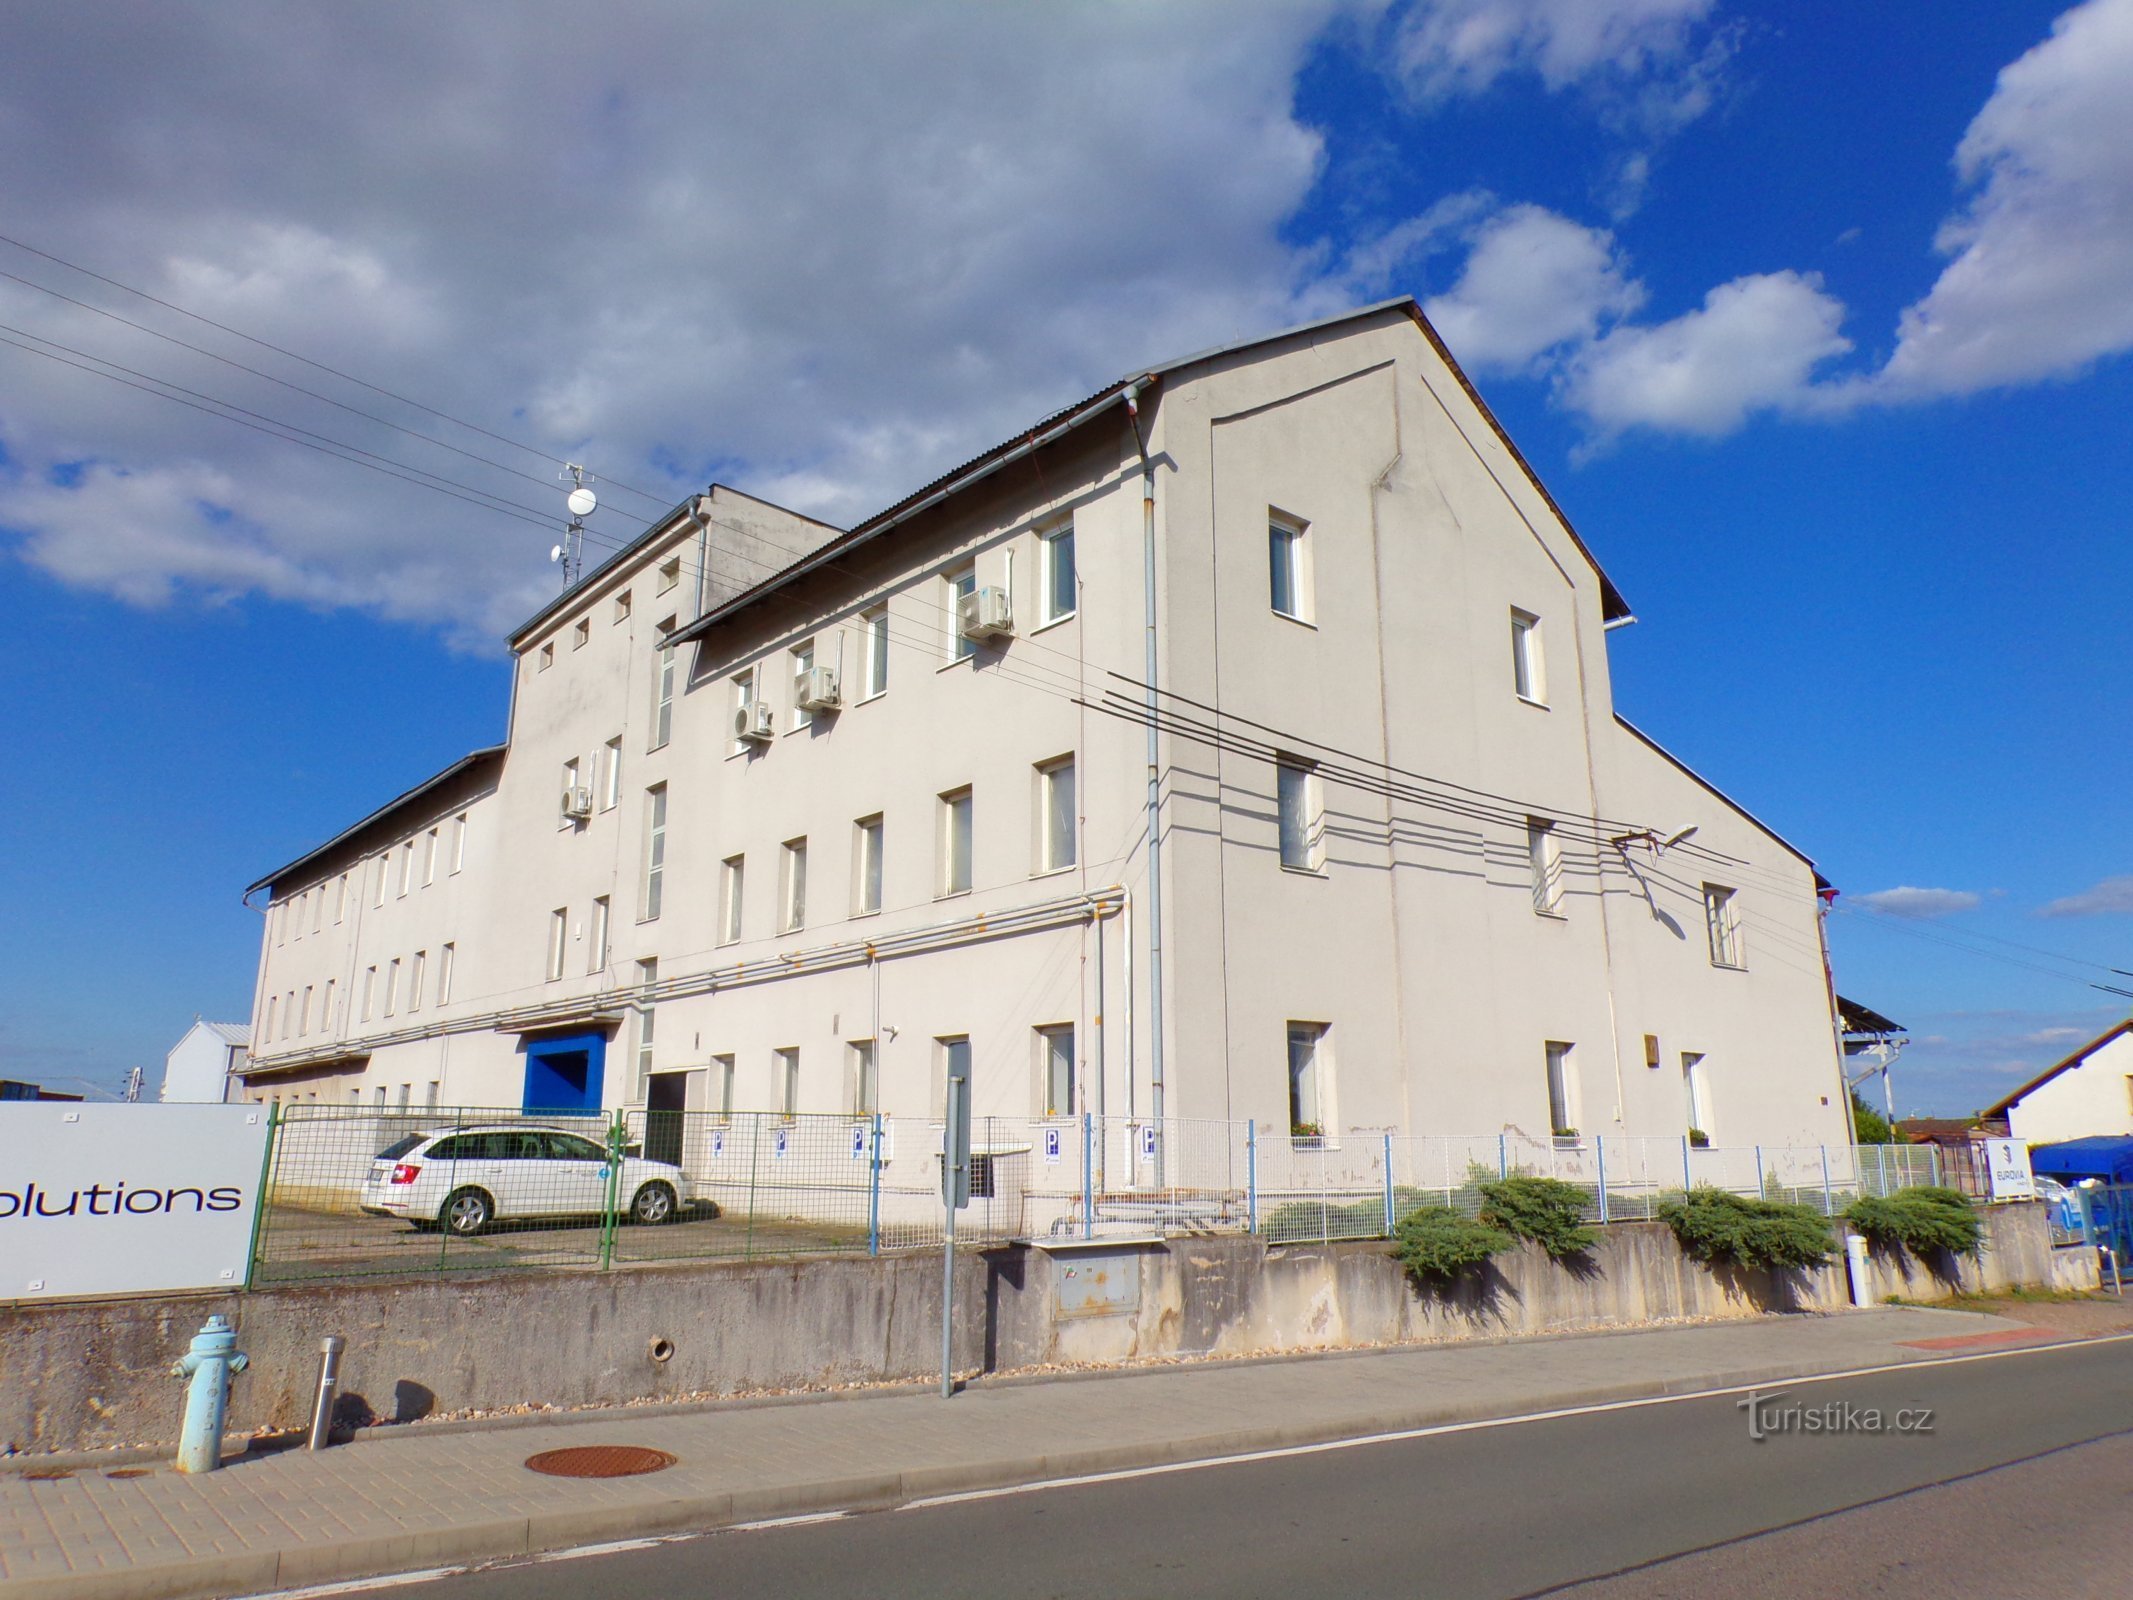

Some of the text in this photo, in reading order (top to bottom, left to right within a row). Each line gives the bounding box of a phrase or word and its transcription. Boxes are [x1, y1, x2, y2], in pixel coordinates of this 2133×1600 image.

[715, 1132, 722, 1150] P
[778, 1131, 785, 1150] P
[854, 1131, 862, 1150] P
[1048, 1131, 1057, 1154] P
[1144, 1127, 1154, 1152] P
[1997, 1170, 2025, 1180] EUROVIA
[0, 1181, 241, 1217] olutions
